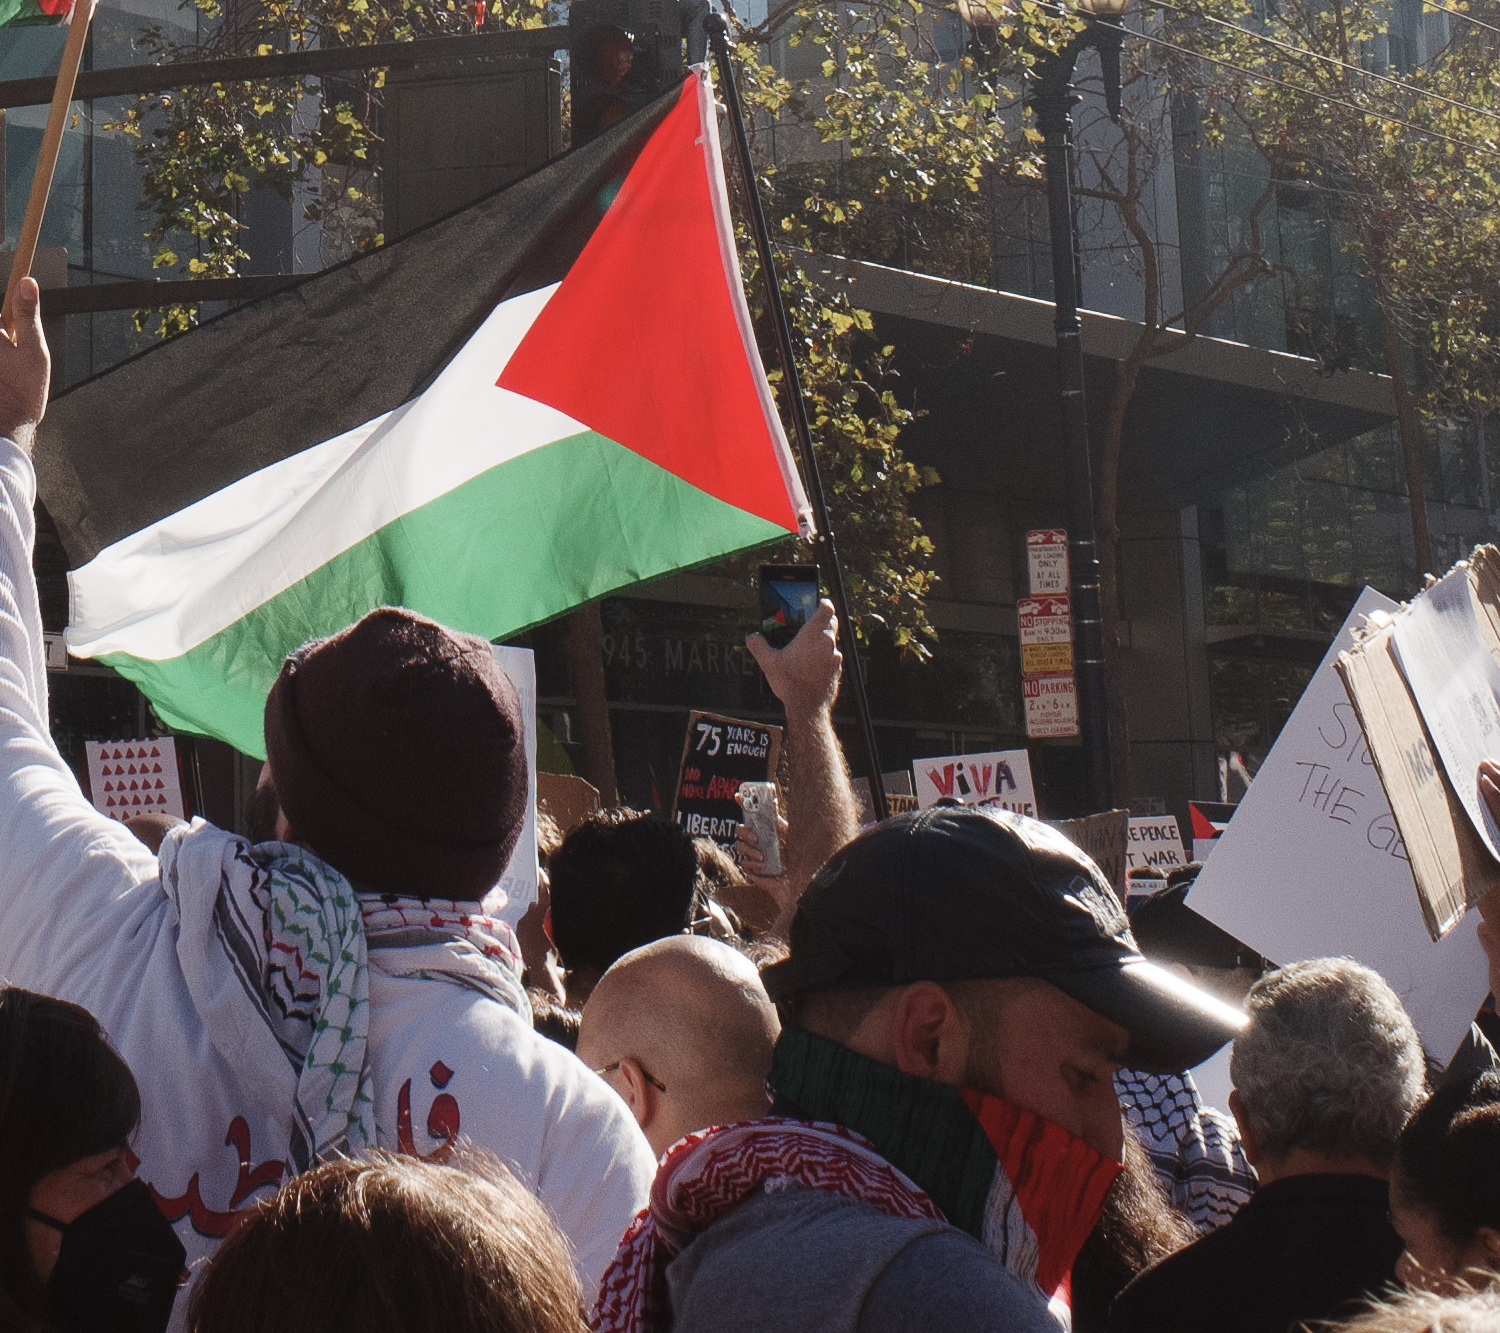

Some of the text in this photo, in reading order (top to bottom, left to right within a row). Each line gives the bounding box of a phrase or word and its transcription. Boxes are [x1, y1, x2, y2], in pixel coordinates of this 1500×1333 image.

[1038, 559, 1058, 568] ONLY
[1037, 571, 1061, 579] AT ALL
[1039, 580, 1060, 589] TIMES
[1020, 615, 1069, 628] NO STOPPING
[603, 634, 755, 676] 945 MARKE
[1024, 680, 1074, 696] NO PARKING
[696, 723, 769, 756] 75 YEARS IS
[726, 743, 767, 758] ENOUGH
[1295, 761, 1366, 825] THE
[1140, 825, 1179, 841] PEACE
[1142, 850, 1180, 866] WAR
